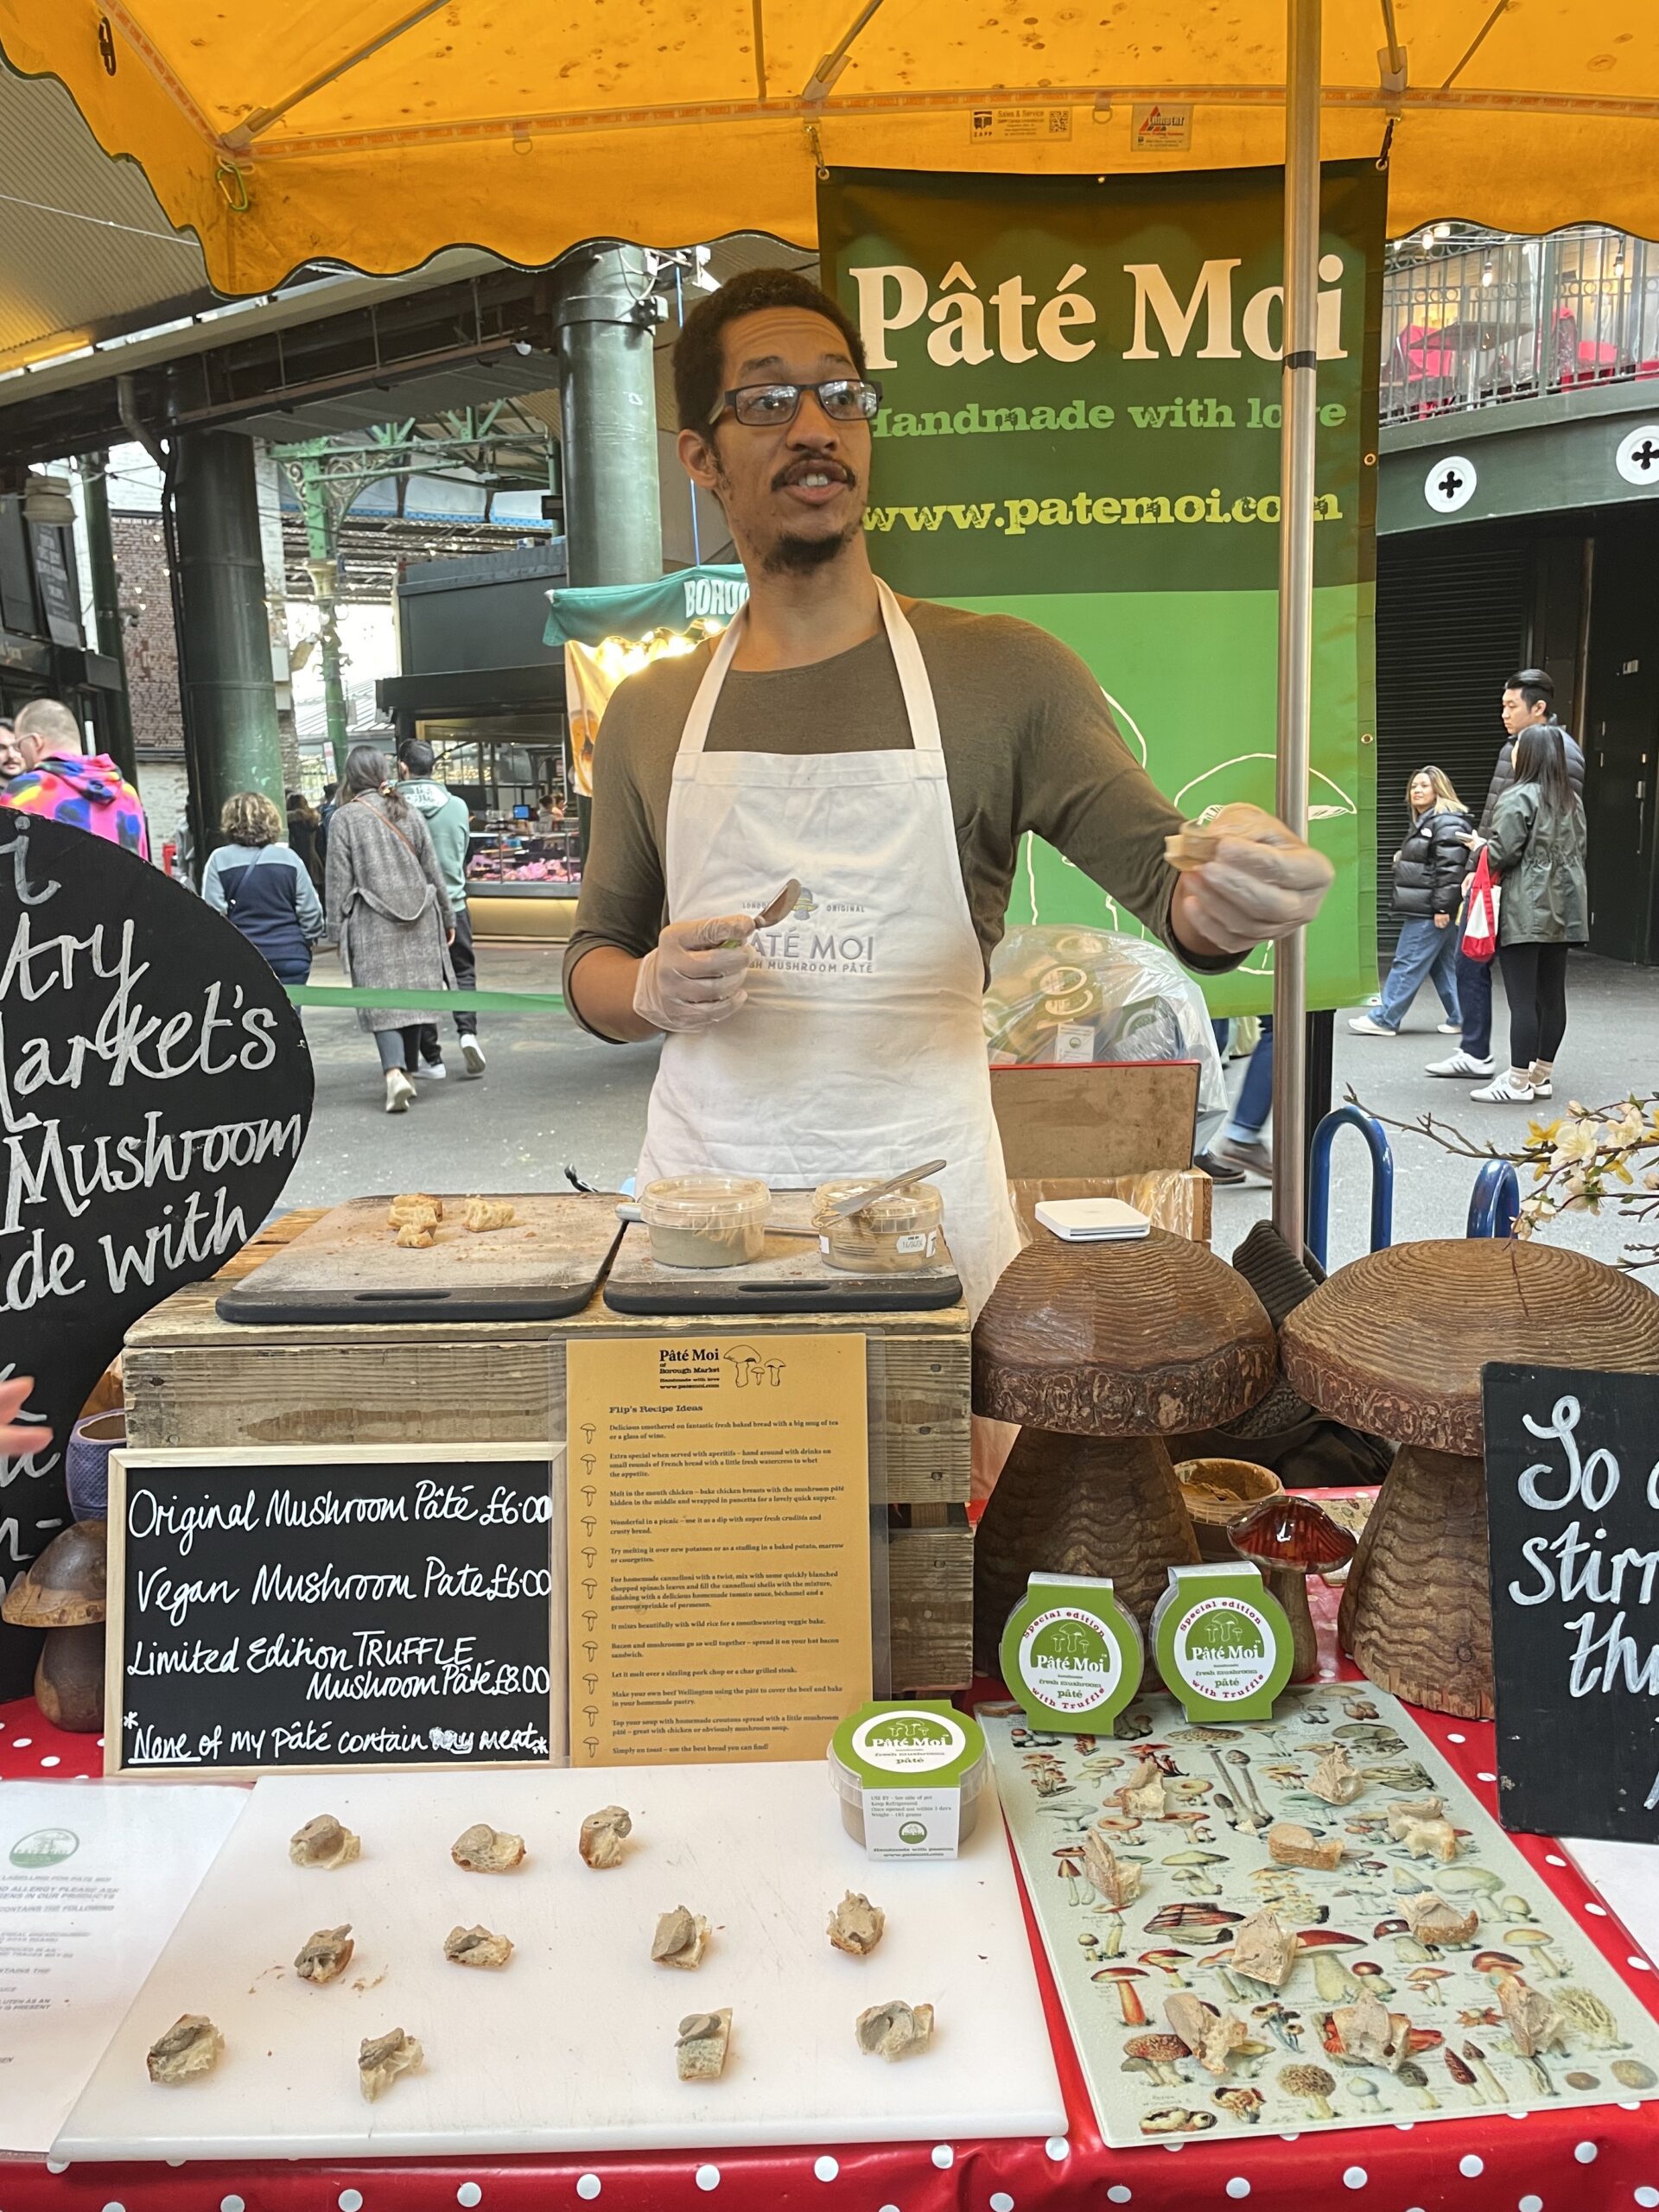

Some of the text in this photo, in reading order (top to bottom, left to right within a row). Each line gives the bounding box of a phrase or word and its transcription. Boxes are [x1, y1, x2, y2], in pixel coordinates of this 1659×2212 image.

[849, 254, 1348, 370] Pâté Moi
[1128, 397, 1236, 429] with
[1247, 398, 1346, 429] loe
[751, 926, 874, 961] ATÉ MOI
[767, 961, 836, 972] MUSHROOM
[0, 980, 277, 1131] arket's
[99, 1186, 248, 1294] with
[659, 1348, 720, 1362] Pâté Moi
[609, 1406, 637, 1414] Flip's
[639, 1405, 673, 1414] Recipe
[794, 1420, 804, 1428] big
[621, 1471, 649, 1479] appetite.
[129, 1490, 259, 1555] Original
[265, 1490, 408, 1528] Mushroom
[415, 1479, 479, 1521] Pâté
[138, 1566, 240, 1626] Vegan
[251, 1562, 417, 1605] Mushroom
[424, 1556, 490, 1599] Pate
[638, 1621, 673, 1630] beautifully
[736, 1618, 785, 1628] mouthwatering
[787, 1618, 807, 1627] veggie
[1023, 1611, 1105, 1638] Special edition
[1180, 1601, 1262, 1631] Special edition
[127, 1630, 477, 1676] Limited Edition TRUFFLE
[1037, 1655, 1104, 1673] Pâté Moi
[1192, 1644, 1258, 1661] Pâté Moi
[306, 1660, 551, 1700] Mushroom Pâté £8.00
[1192, 1674, 1264, 1699] with Truffle
[1215, 1678, 1240, 1688] pâté
[674, 1698, 695, 1707] pastry.
[1032, 1688, 1105, 1709] with Truffle
[1058, 1689, 1083, 1699] pâté
[199, 1725, 223, 1760] of
[230, 1730, 266, 1759] my
[338, 1725, 429, 1754] contain
[872, 1737, 946, 1746] Pâté Moi
